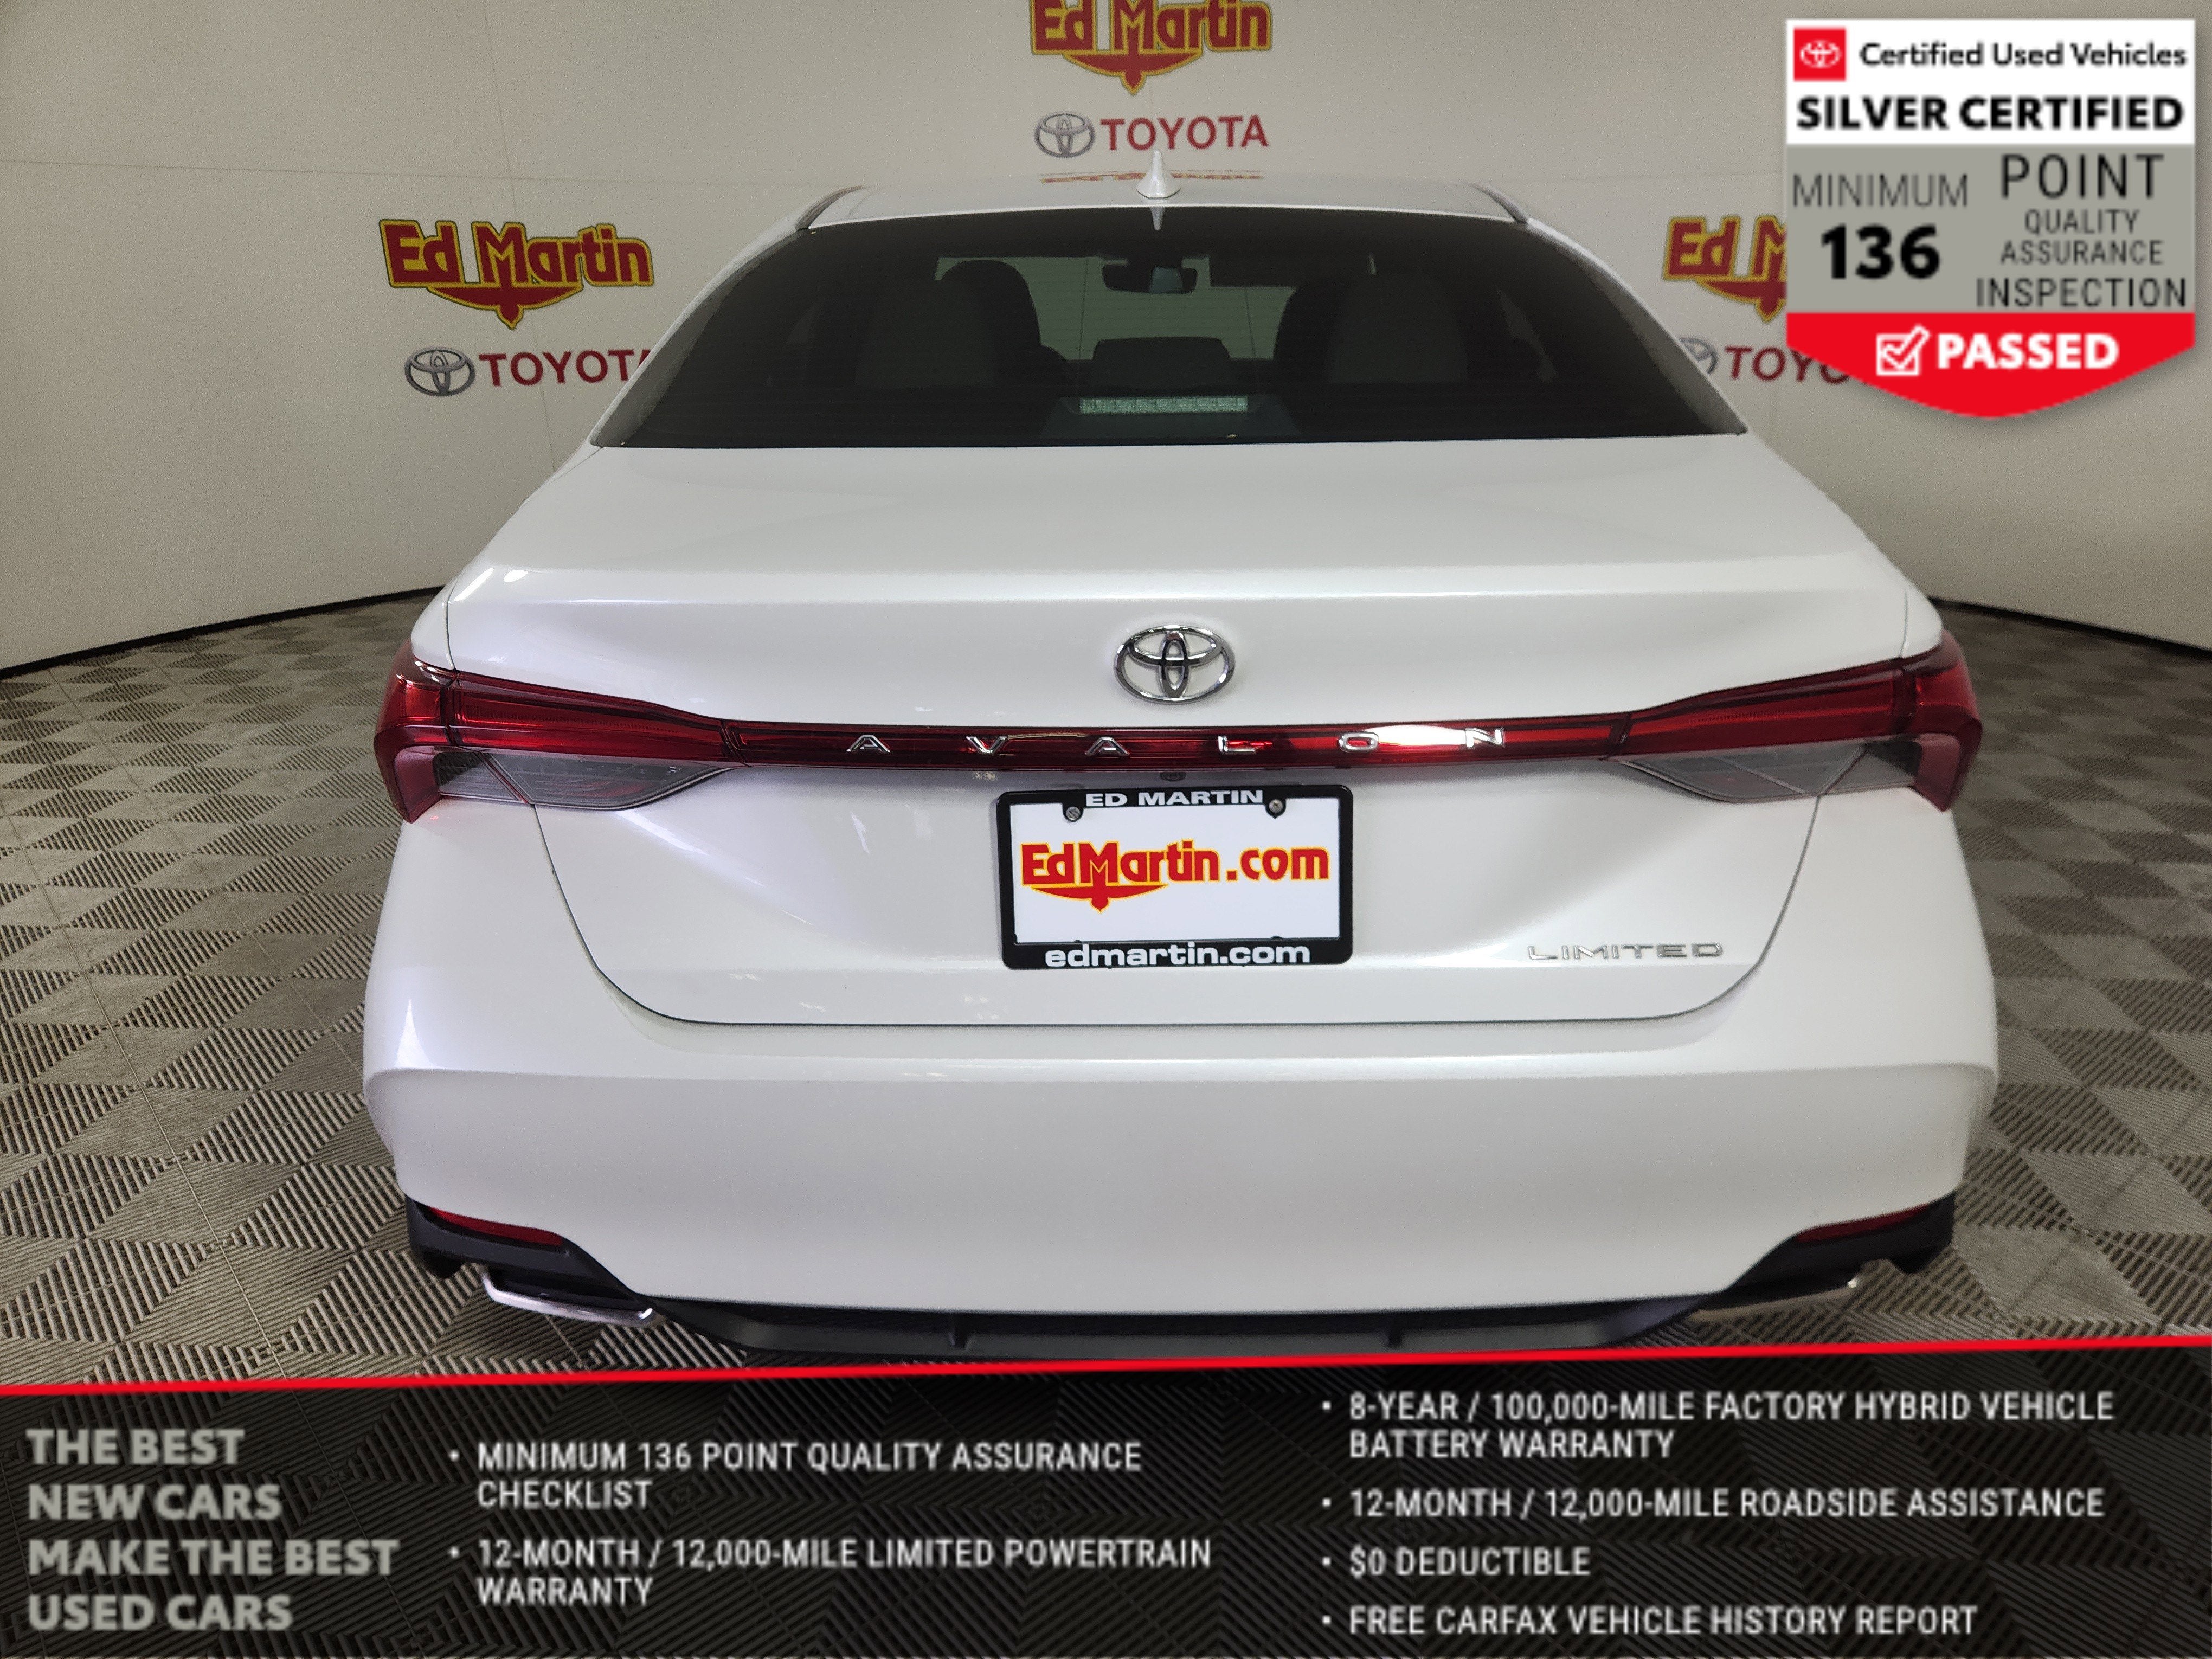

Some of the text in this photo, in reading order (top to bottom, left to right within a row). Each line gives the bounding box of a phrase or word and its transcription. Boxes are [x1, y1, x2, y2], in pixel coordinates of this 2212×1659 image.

[1030, 0, 1273, 55] Ed Martin
[1101, 115, 1269, 151] TOYOTA
[380, 219, 654, 288] Ed Martin
[1663, 216, 1741, 280] Ed
[479, 349, 650, 387] TOYOT
[847, 727, 1506, 756] AVALON
[1085, 790, 1263, 807] ED MARTIN
[1020, 840, 1330, 886] EdMartin.com
[1045, 942, 1310, 967] edmartin.com
[1527, 944, 1724, 960] LIMITED
